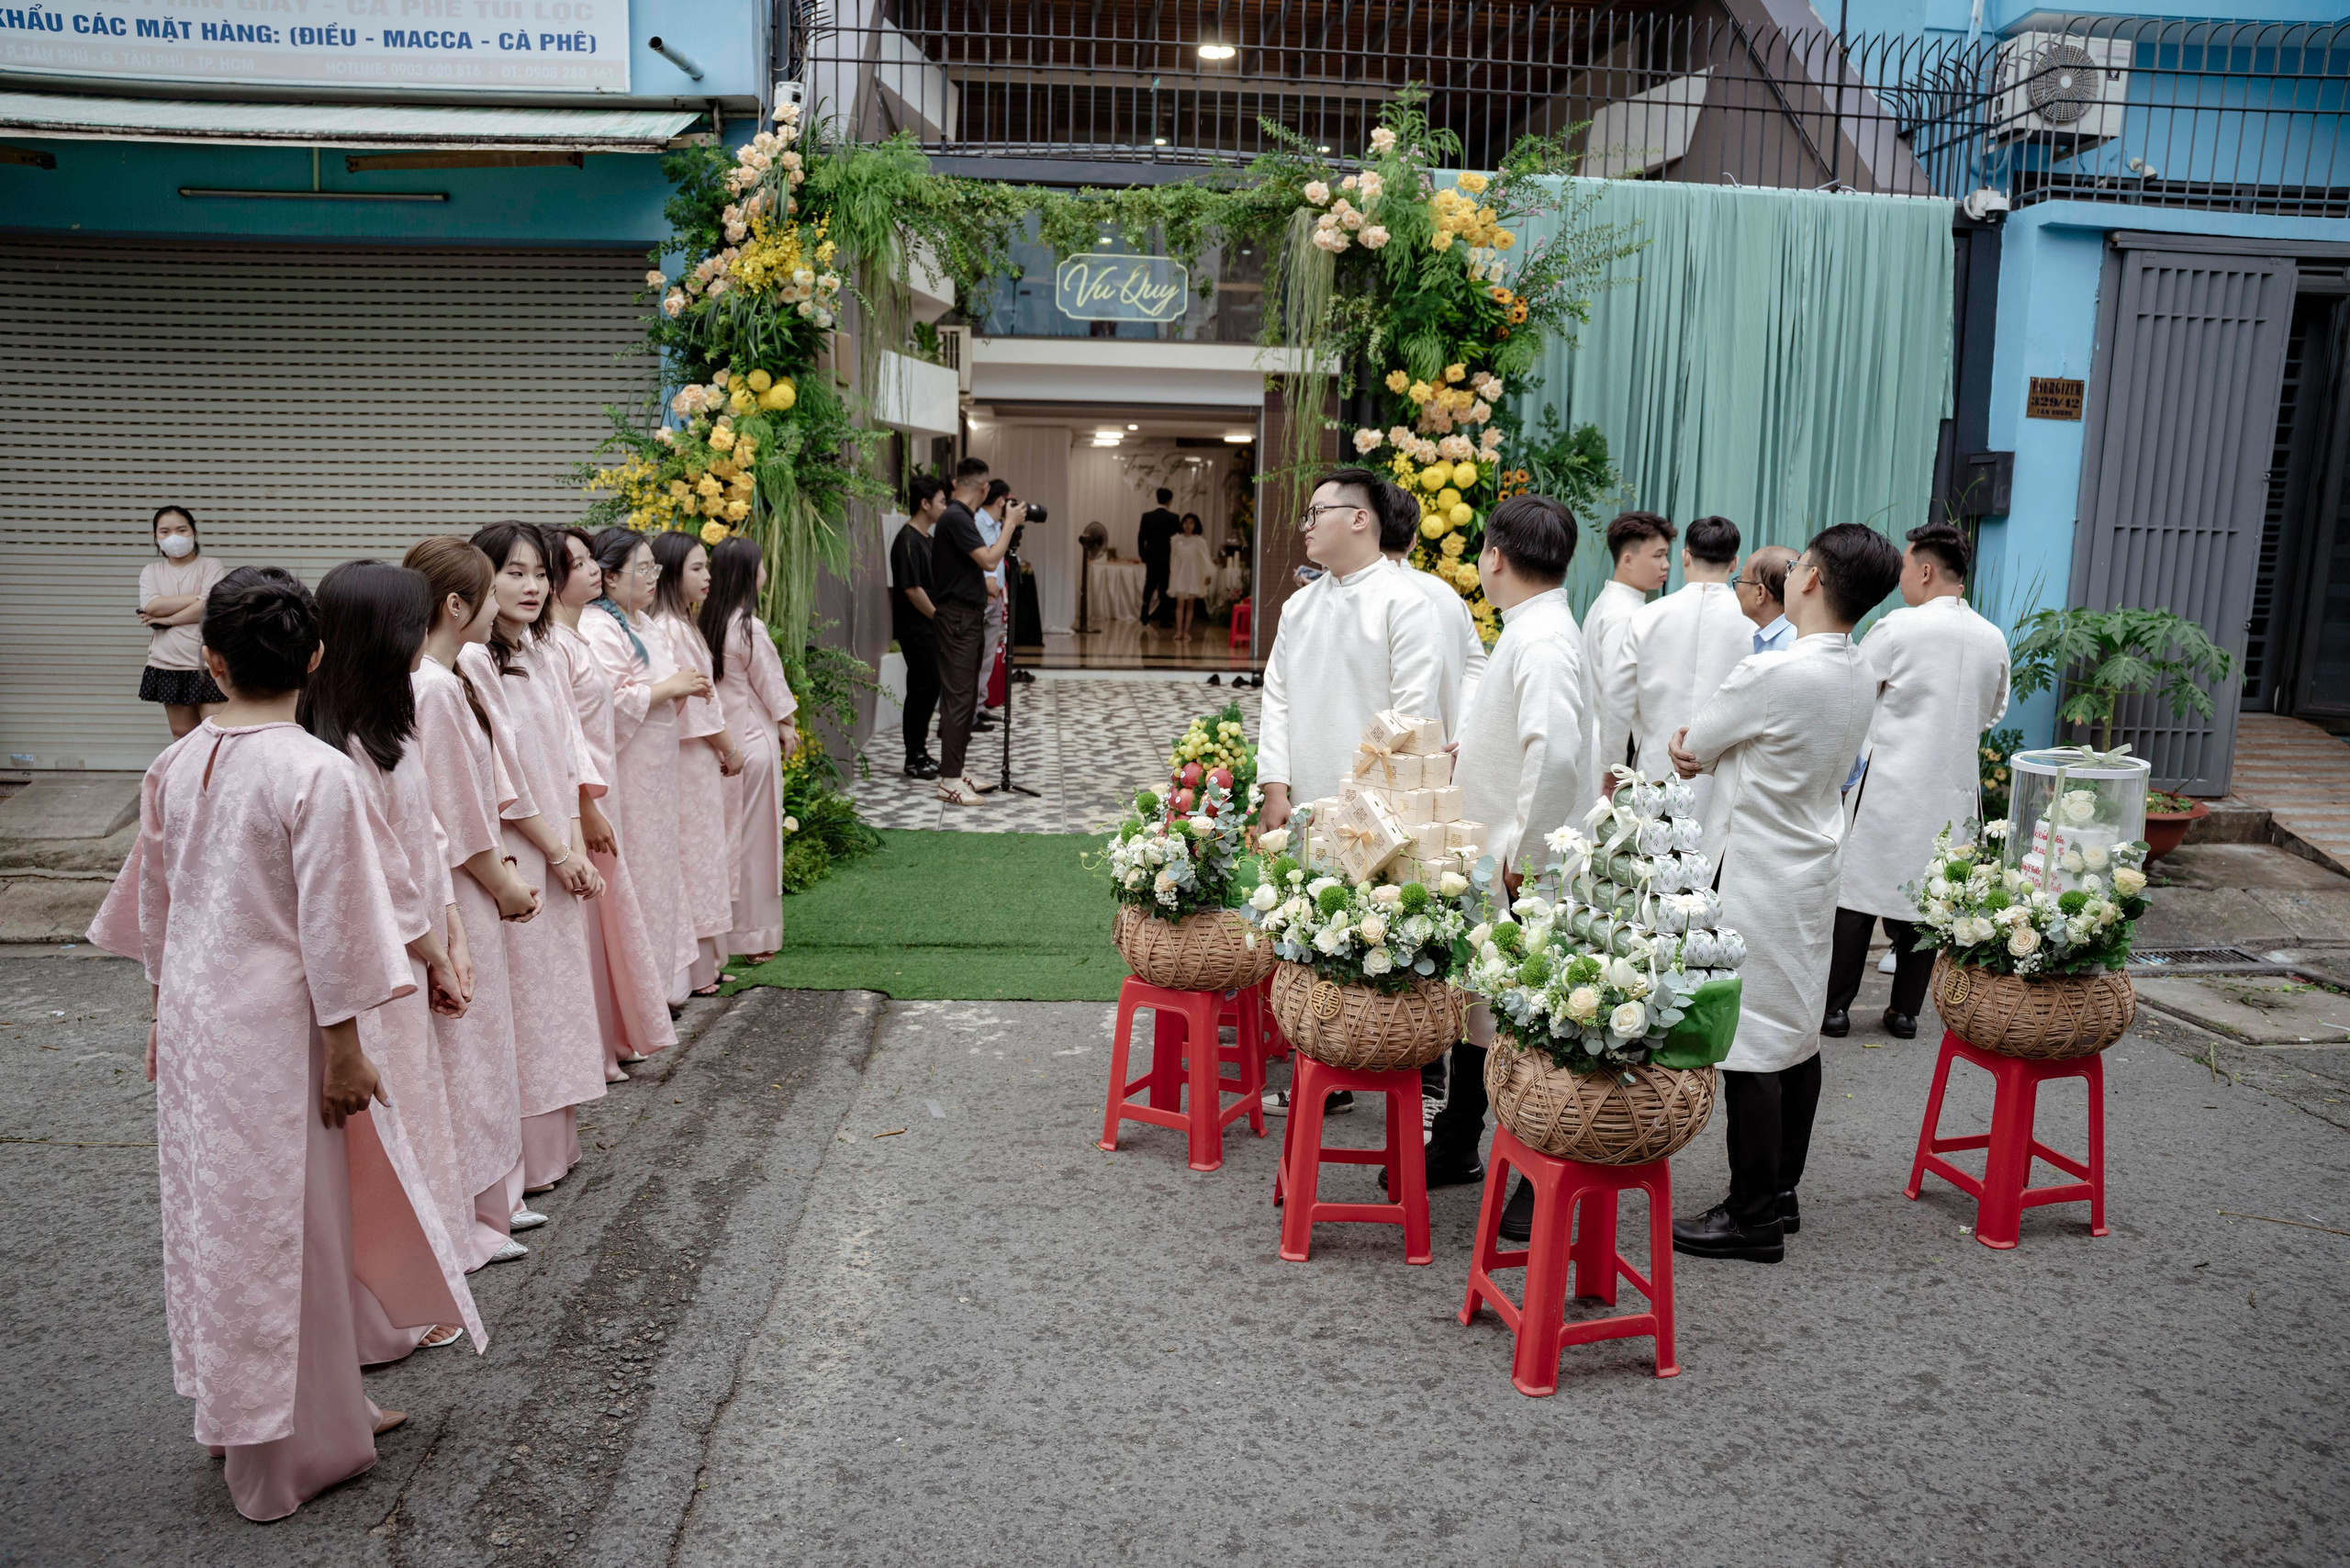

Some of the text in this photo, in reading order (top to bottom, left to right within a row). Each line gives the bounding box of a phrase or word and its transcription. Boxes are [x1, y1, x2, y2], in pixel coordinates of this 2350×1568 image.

[534, 2, 594, 25] LỌC
[73, 12, 127, 36] CÁC
[136, 16, 192, 43] MẶT
[201, 19, 280, 44] HÀNG:
[290, 22, 356, 47] (ĐIỀU
[383, 29, 473, 50] MACCA
[498, 28, 532, 50] CÀ
[540, 30, 597, 54] PHÊ)
[23, 44, 53, 62] TÂN
[58, 47, 89, 63] PHÚ
[101, 51, 118, 65] Q.
[122, 49, 151, 67] TÂN
[156, 51, 184, 68] PHÚ
[197, 56, 216, 70] TP.
[220, 57, 255, 71] HCM
[326, 61, 386, 75] HOTLINE:
[391, 62, 423, 76] 0903
[1063, 263, 1181, 317] Vu Quy
